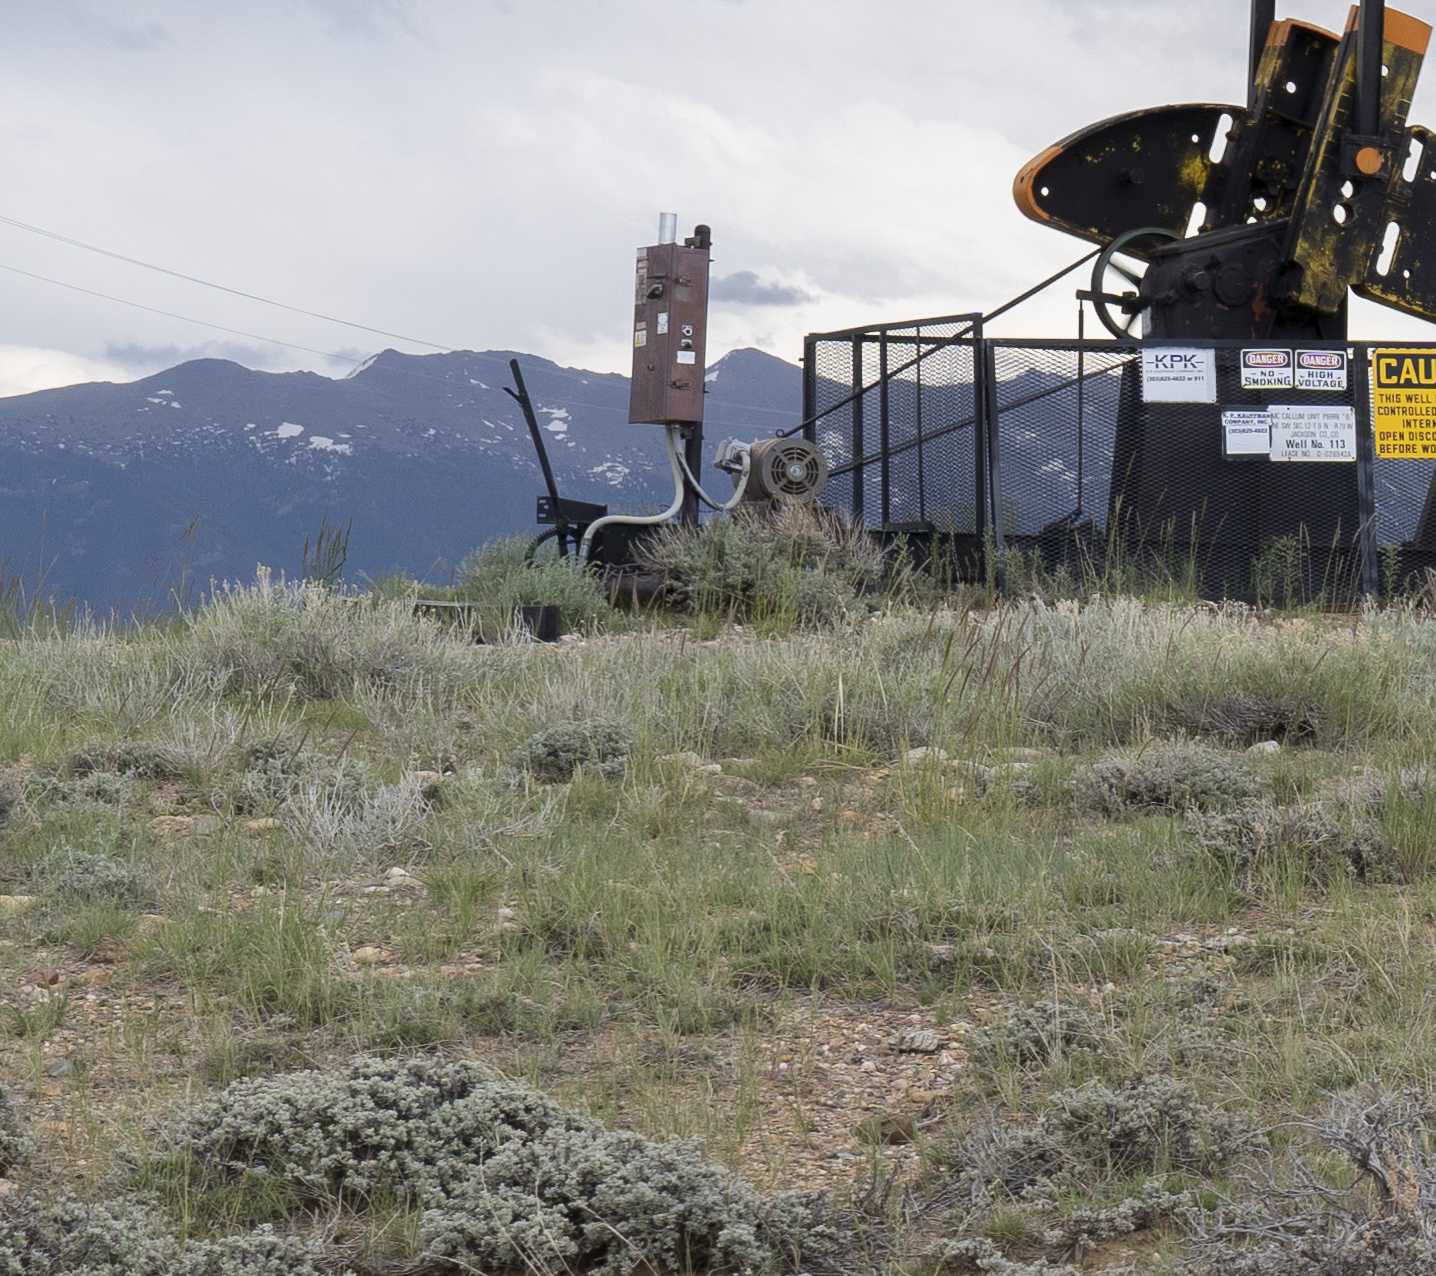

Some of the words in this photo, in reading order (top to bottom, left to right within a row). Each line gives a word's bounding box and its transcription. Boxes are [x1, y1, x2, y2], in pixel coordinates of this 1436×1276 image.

[1155, 354, 1198, 369] KPK
[1249, 354, 1284, 364] DANGER
[1303, 355, 1339, 366] DANGER
[1307, 370, 1334, 379] HIGH
[1244, 376, 1291, 386] SMOKING
[1297, 379, 1344, 388] VOLTAGE
[1379, 393, 1401, 404] THIS
[1405, 393, 1432, 404] WELL
[1377, 406, 1436, 416] CONTROLLED
[1379, 431, 1405, 442] OPEN
[1285, 439, 1307, 449] Well
[1311, 439, 1325, 449] No.
[1329, 439, 1346, 449] 113
[1379, 444, 1417, 454] BEFORE
